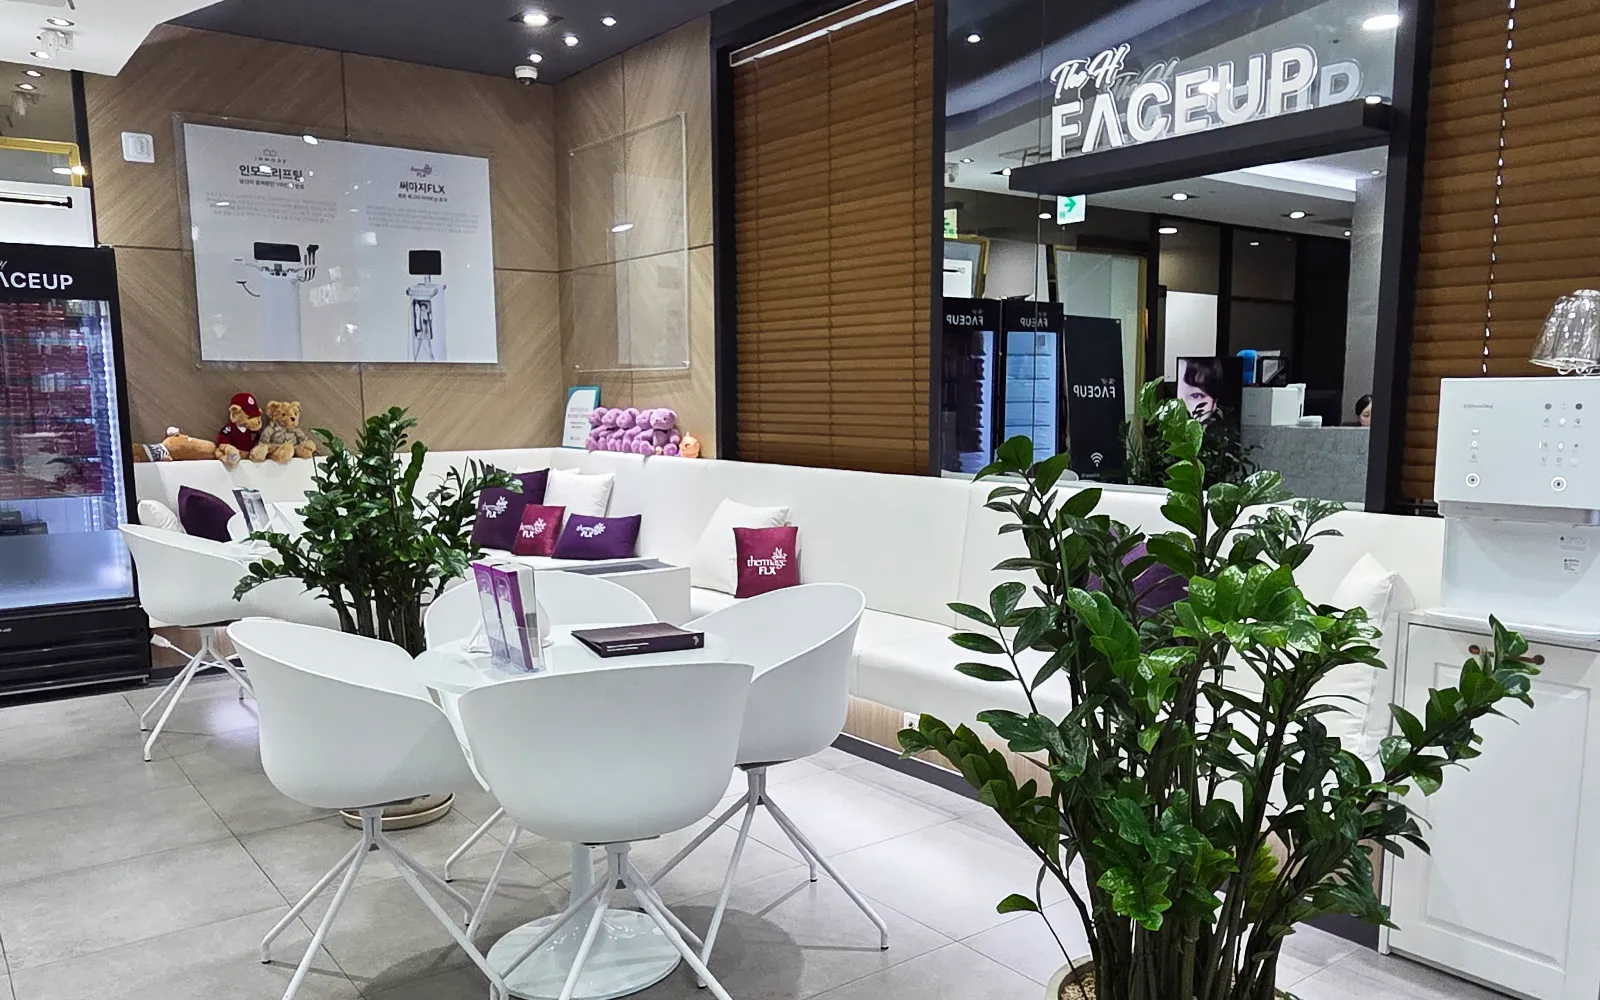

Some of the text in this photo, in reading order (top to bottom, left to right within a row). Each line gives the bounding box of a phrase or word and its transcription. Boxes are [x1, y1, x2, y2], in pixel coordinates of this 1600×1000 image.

[1050, 46, 1318, 161] FACEUP
[399, 180, 446, 195] 써마지FLX
[758, 566, 777, 576] FLX
